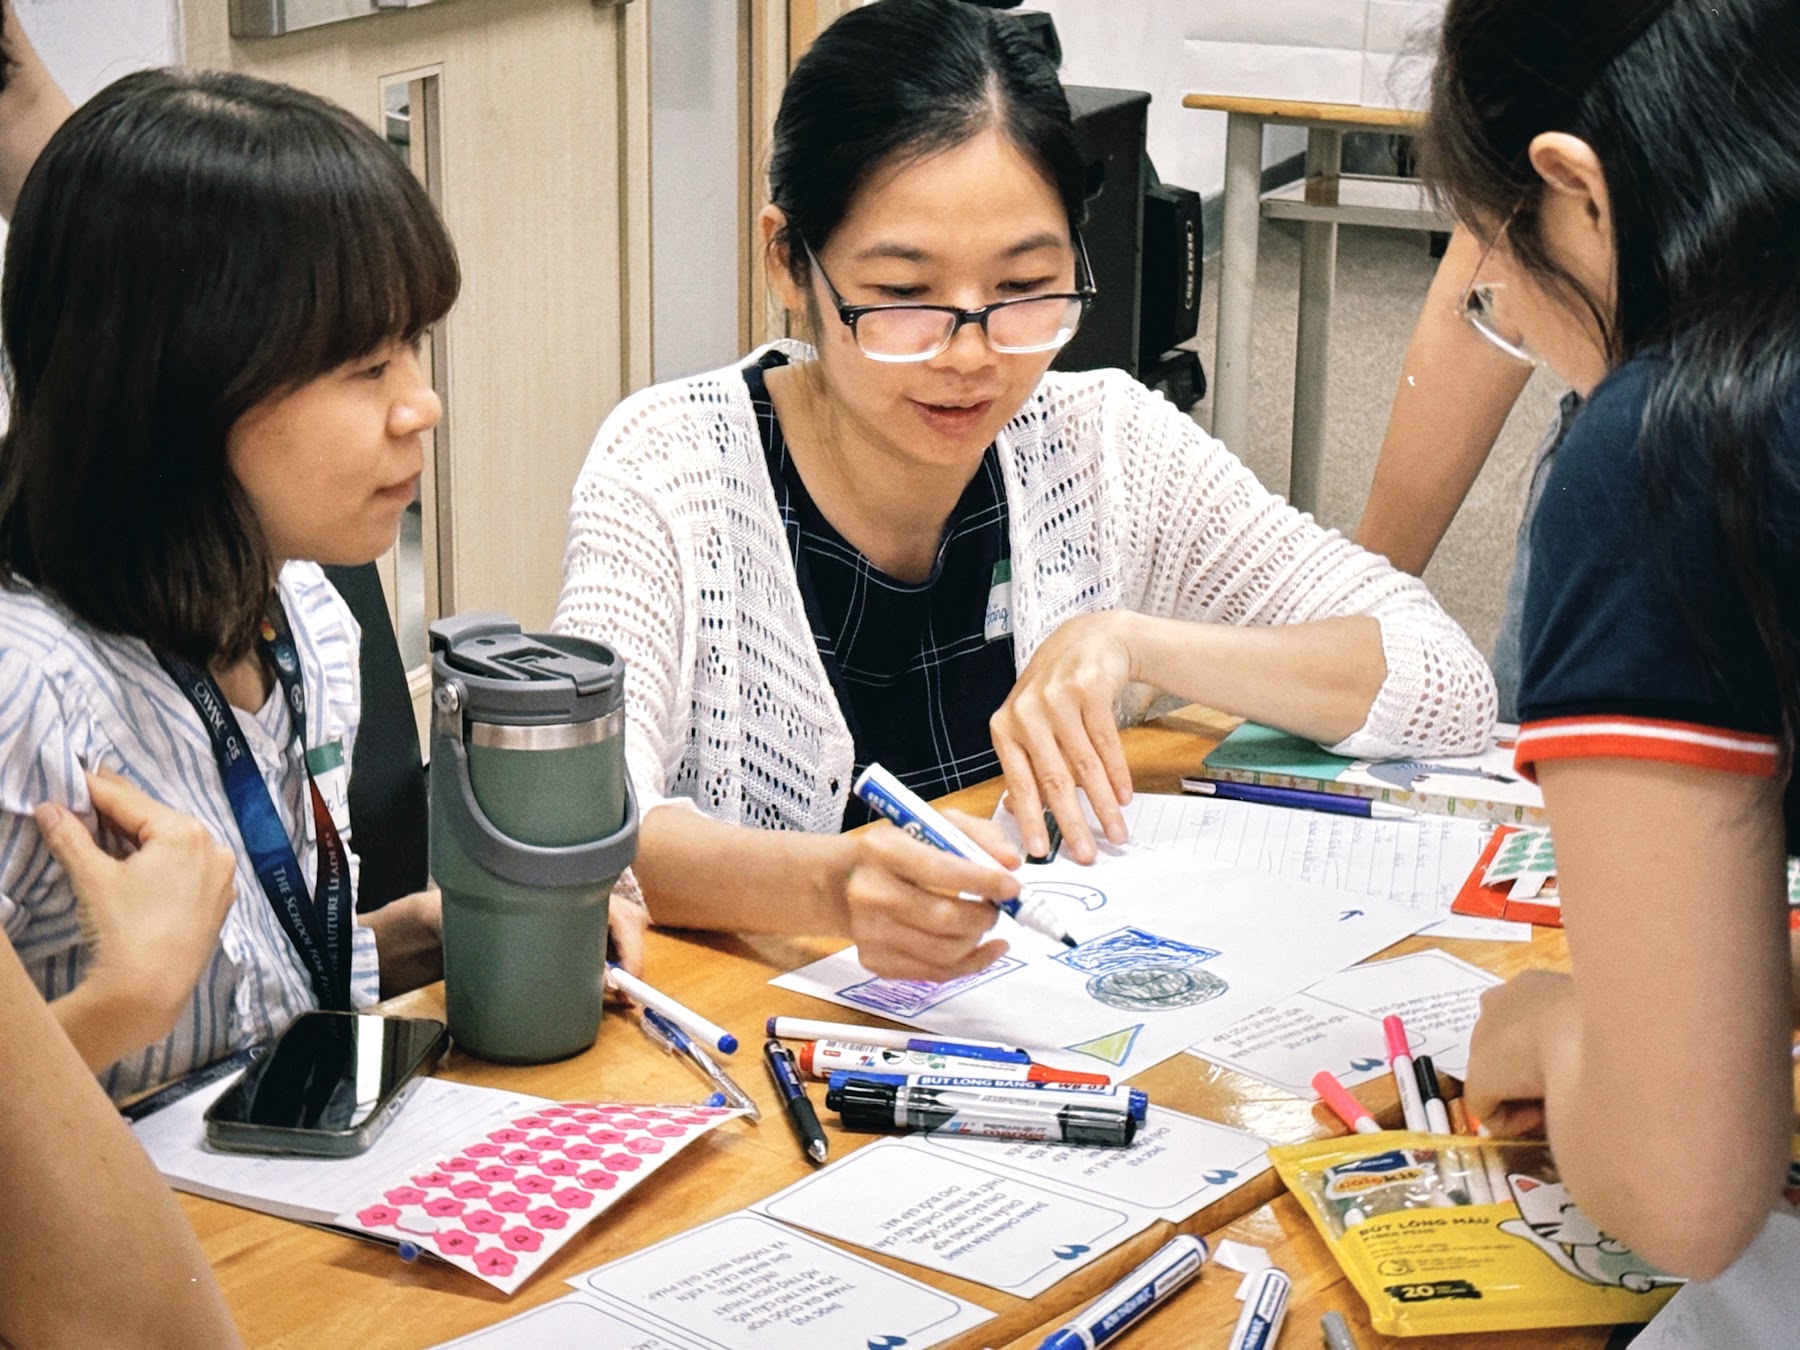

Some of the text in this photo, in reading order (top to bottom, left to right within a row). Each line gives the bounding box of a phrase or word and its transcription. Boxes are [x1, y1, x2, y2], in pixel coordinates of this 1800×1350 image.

[769, 1253, 792, 1263] GHI
[713, 1274, 739, 1285] CÁC
[798, 1284, 819, 1293] VAI
[822, 1284, 856, 1298] THAM
[1401, 1286, 1435, 1298] 20
[801, 1296, 824, 1306] GIA
